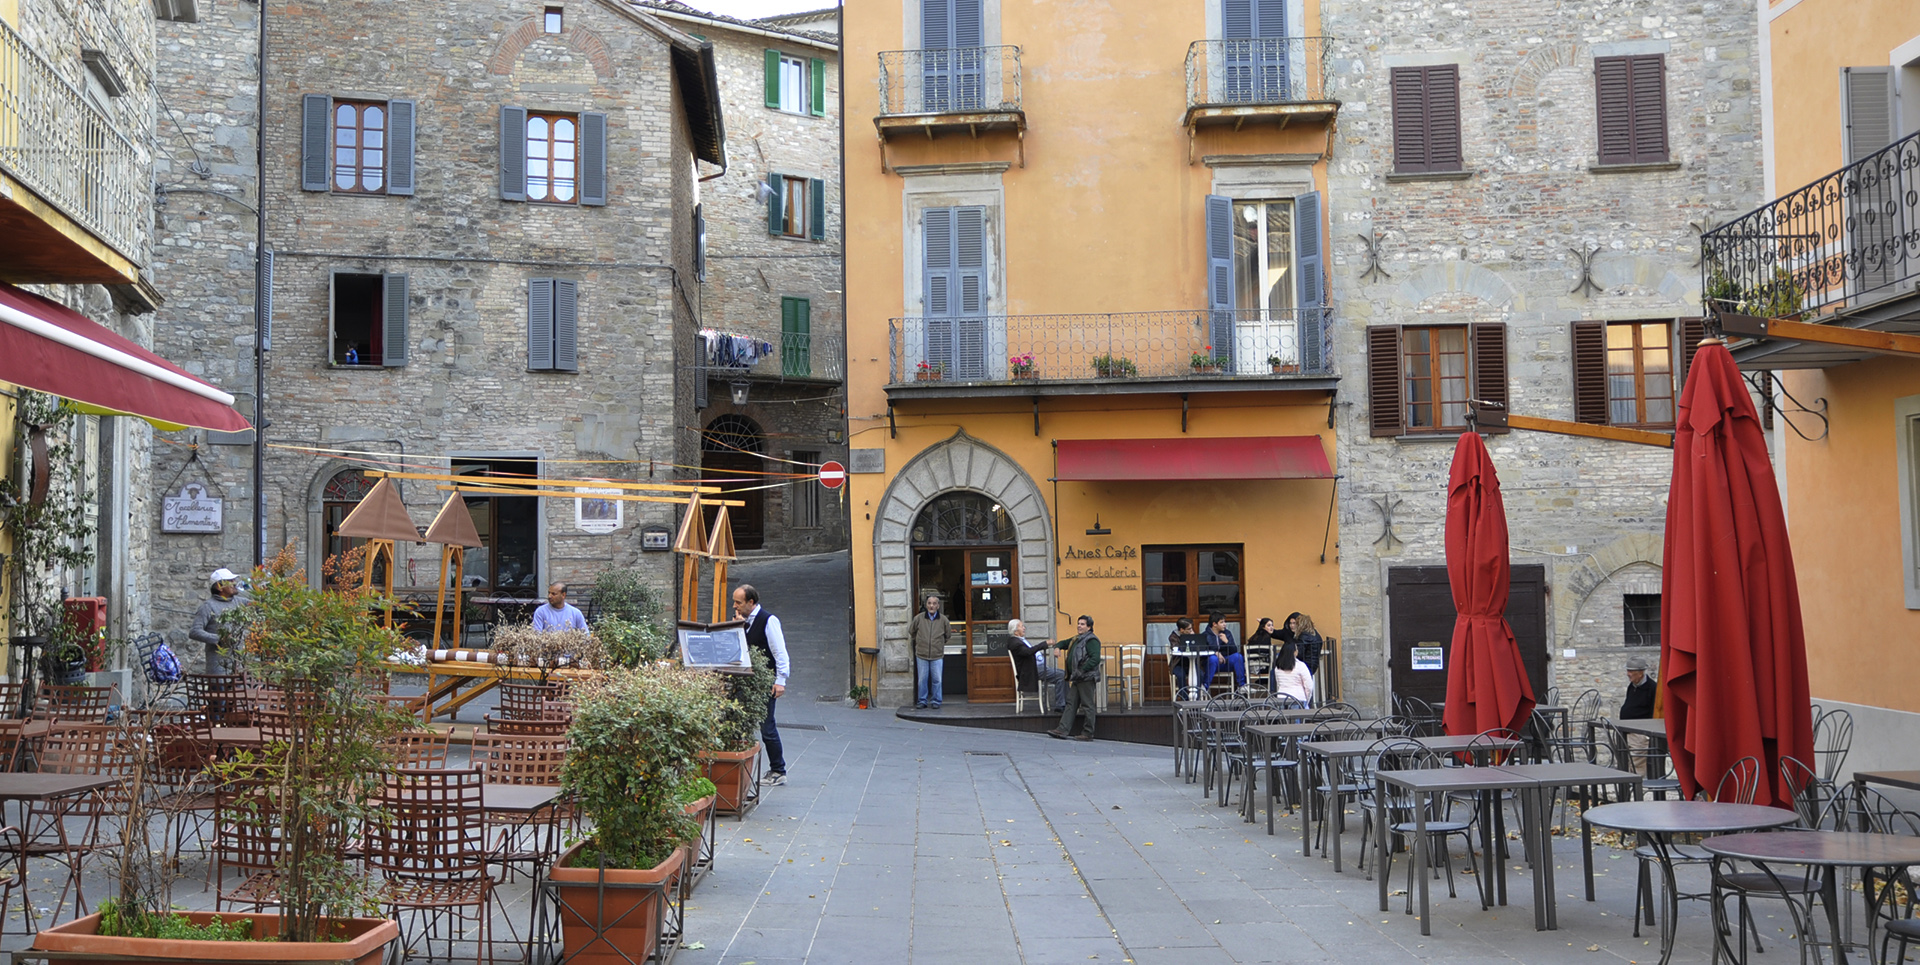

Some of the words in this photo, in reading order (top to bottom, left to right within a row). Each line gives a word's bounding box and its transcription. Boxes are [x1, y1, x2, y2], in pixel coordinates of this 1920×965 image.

[1065, 545, 1102, 559] Aries
[1104, 544, 1138, 560] Café
[1065, 569, 1081, 578] Bar
[1085, 566, 1137, 578] Gelateria
